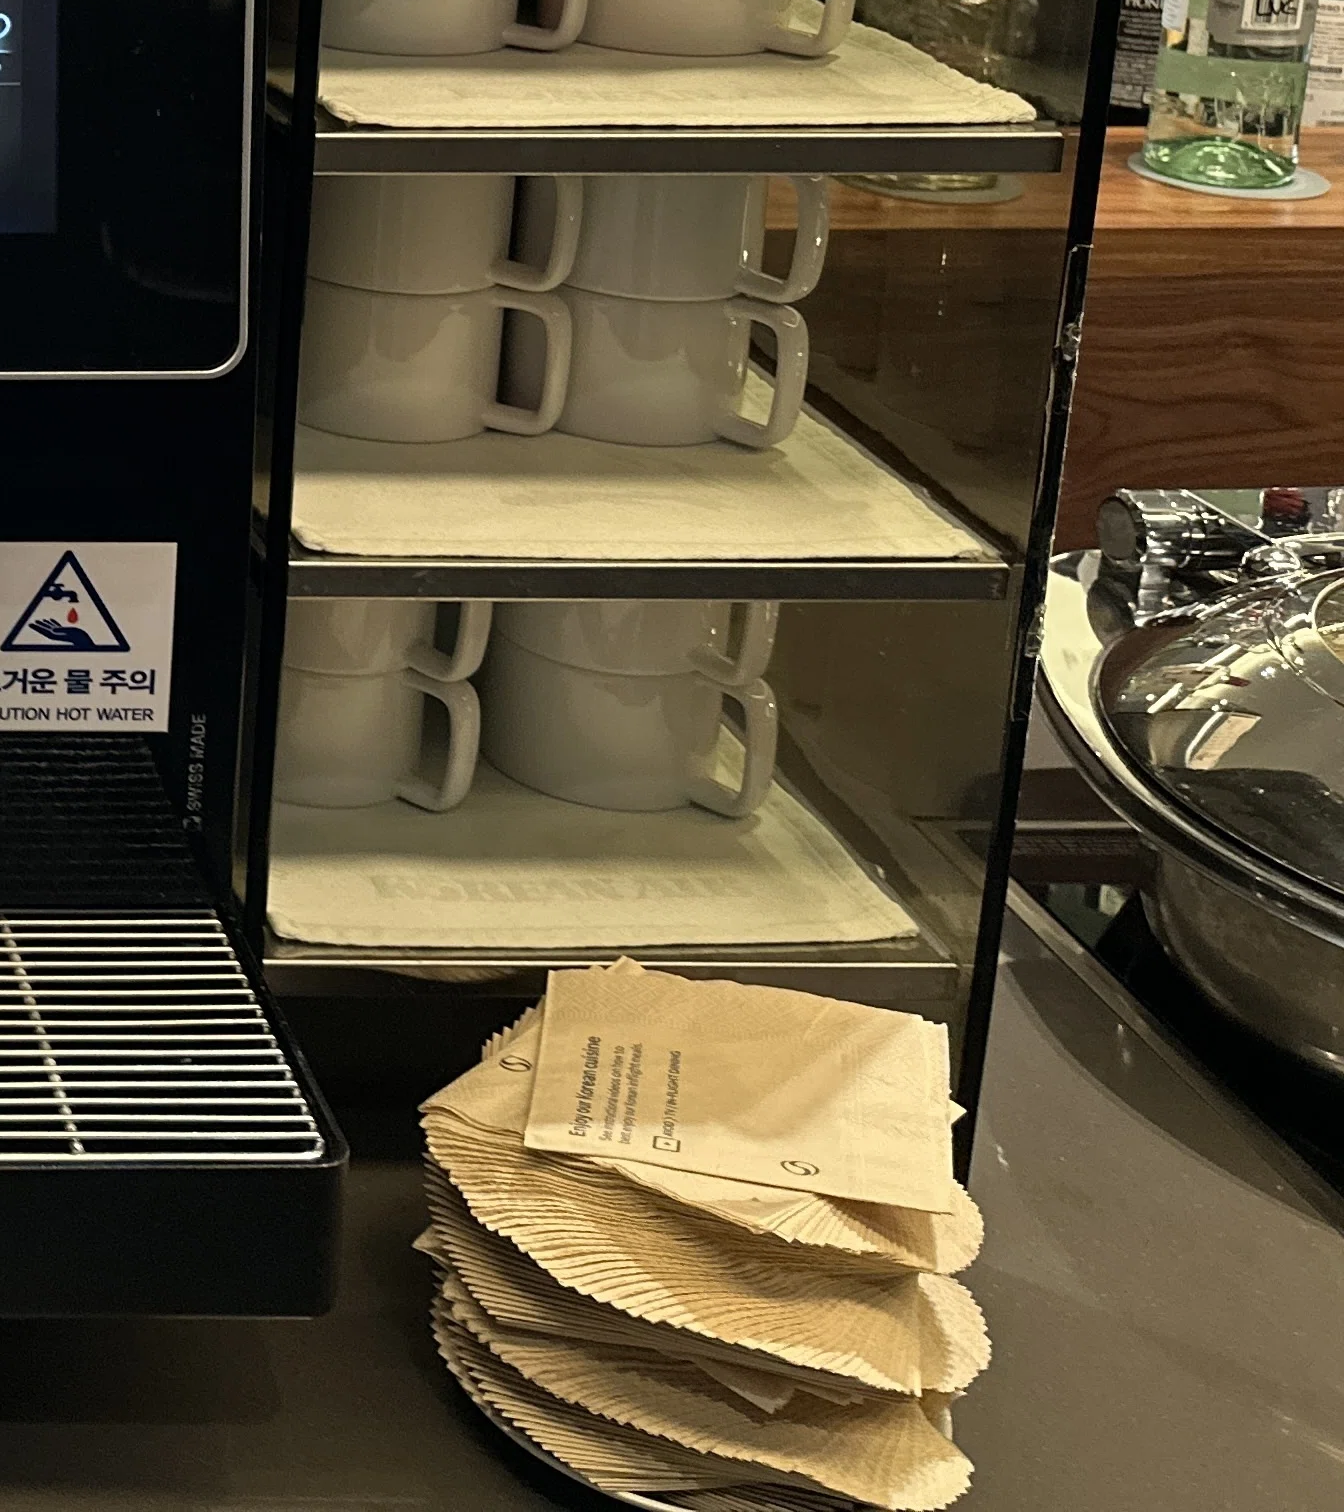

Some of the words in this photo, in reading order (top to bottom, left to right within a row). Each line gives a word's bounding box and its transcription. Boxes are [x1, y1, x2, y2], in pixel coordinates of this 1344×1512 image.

[64, 670, 93, 695] 물
[100, 669, 156, 695] 주의
[56, 706, 92, 721] HOT
[96, 706, 154, 721] WATER
[190, 713, 208, 762] MADE
[186, 764, 205, 812] SWISS
[580, 1035, 601, 1069] cuisine
[613, 1045, 625, 1054] to
[575, 1069, 597, 1100] Korean
[576, 1100, 592, 1114] our
[568, 1115, 593, 1137] Enjoy
